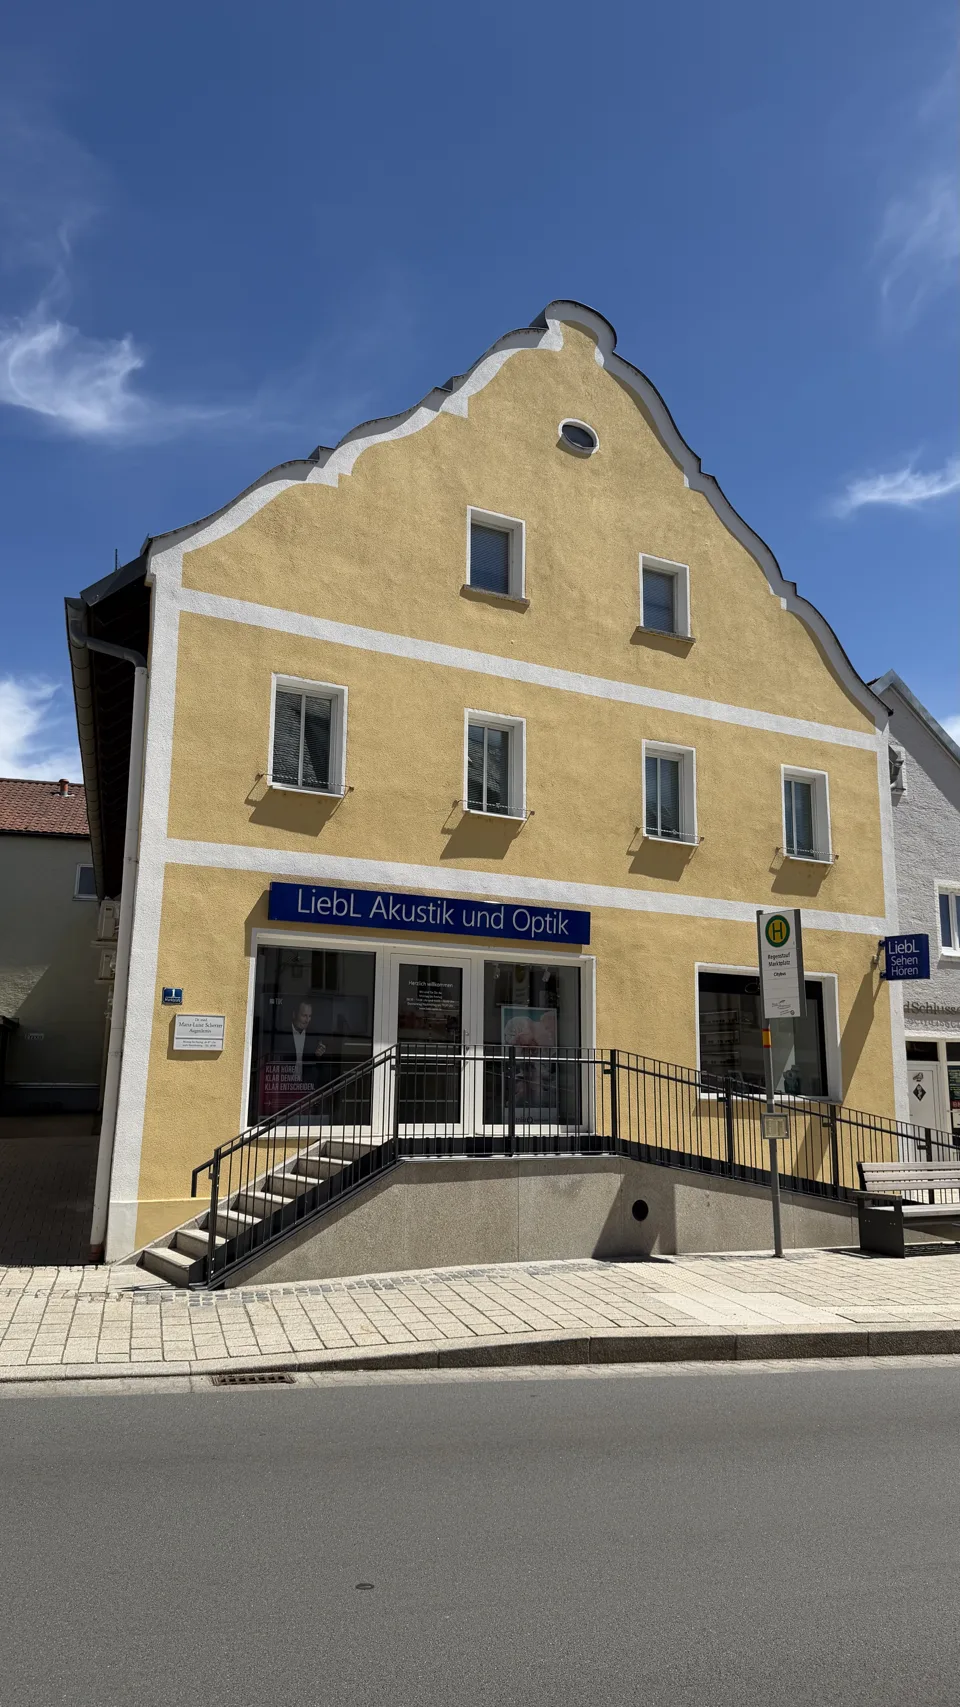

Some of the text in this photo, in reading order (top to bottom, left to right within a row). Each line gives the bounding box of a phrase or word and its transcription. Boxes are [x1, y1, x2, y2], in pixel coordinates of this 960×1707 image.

[298, 888, 569, 938] LiebL Akustik und Optik
[772, 922, 783, 940] H
[888, 939, 920, 954] LiebL
[768, 952, 790, 961] Regenstauf
[891, 955, 918, 966] Sehen
[891, 965, 918, 976] Hören
[172, 989, 176, 997] 1
[265, 1065, 280, 1073] KLAR
[265, 1074, 303, 1082] KLAR DENKEN.
[264, 1082, 316, 1091] KLAR ENTSCHEIDEN.
